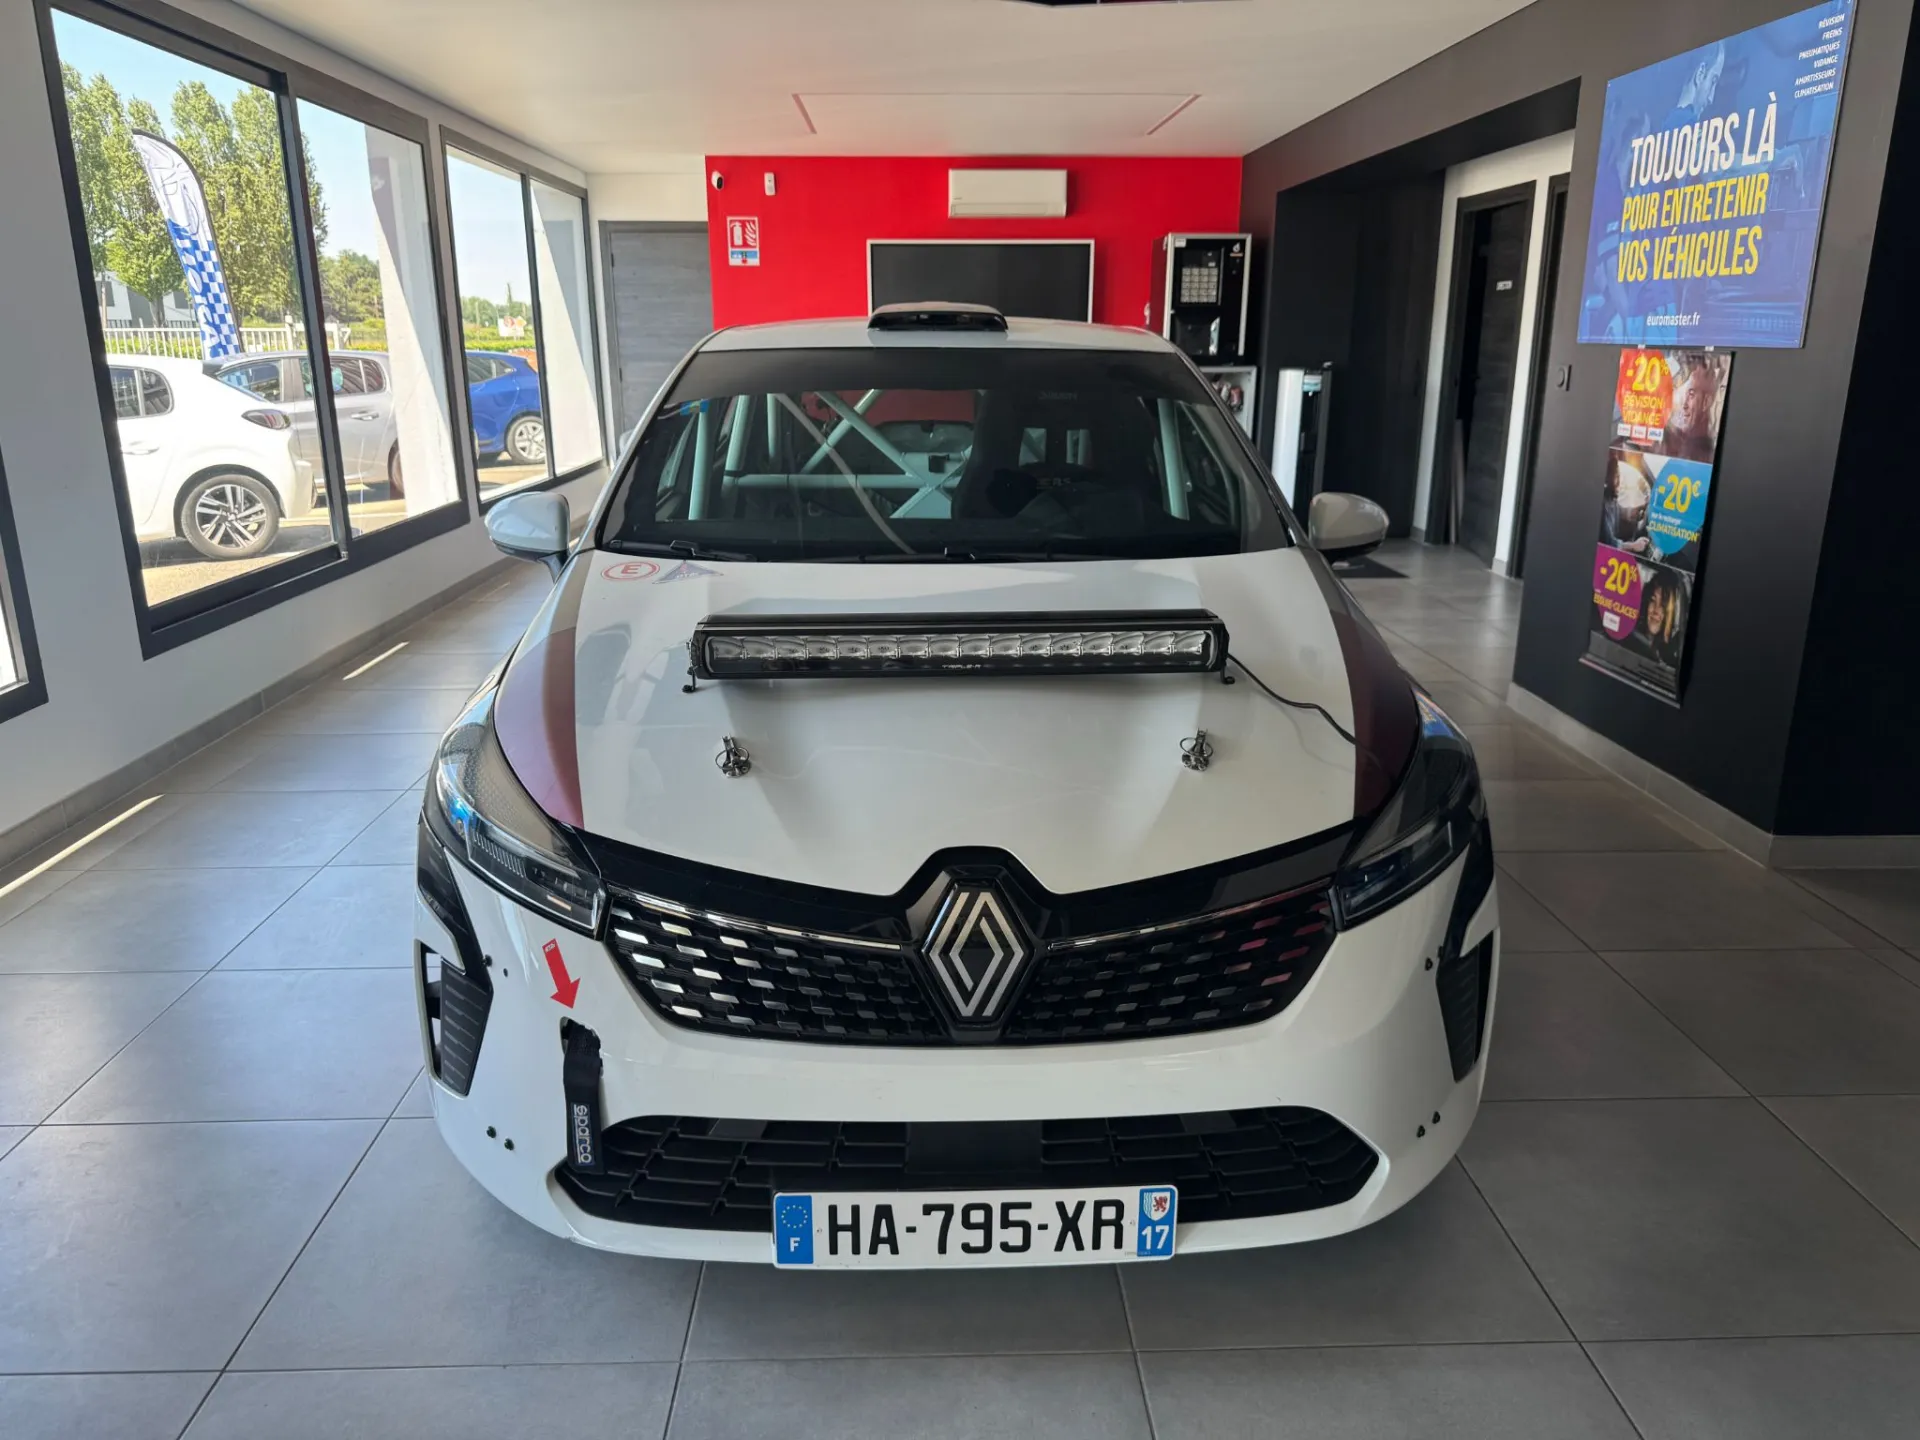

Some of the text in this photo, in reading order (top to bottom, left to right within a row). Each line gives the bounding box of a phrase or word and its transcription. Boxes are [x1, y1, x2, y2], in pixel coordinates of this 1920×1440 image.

[1818, 13, 1845, 29] RÉVISION
[1822, 27, 1843, 40] FREINS
[1798, 41, 1841, 60] PNEUMATIQUES
[1814, 55, 1839, 68] VIDANGE
[1795, 68, 1836, 86] AMORTISSEURS
[1794, 82, 1834, 99] CLIMATISATION
[1629, 91, 1778, 188] TOUJOURS LÀ
[1621, 172, 1770, 233] POUR ENTRETENIR
[1617, 225, 1763, 283] VOS VÉHICULES
[1646, 311, 1701, 327] euromaster.fr
[1626, 352, 1669, 393] -20%
[1657, 473, 1702, 513] -20€
[621, 564, 642, 574] E
[1600, 557, 1638, 595] -20%
[574, 1104, 592, 1163] sparco
[828, 1198, 1125, 1256] HA-795-XR
[1141, 1224, 1170, 1251] 17
[789, 1237, 799, 1252] F
